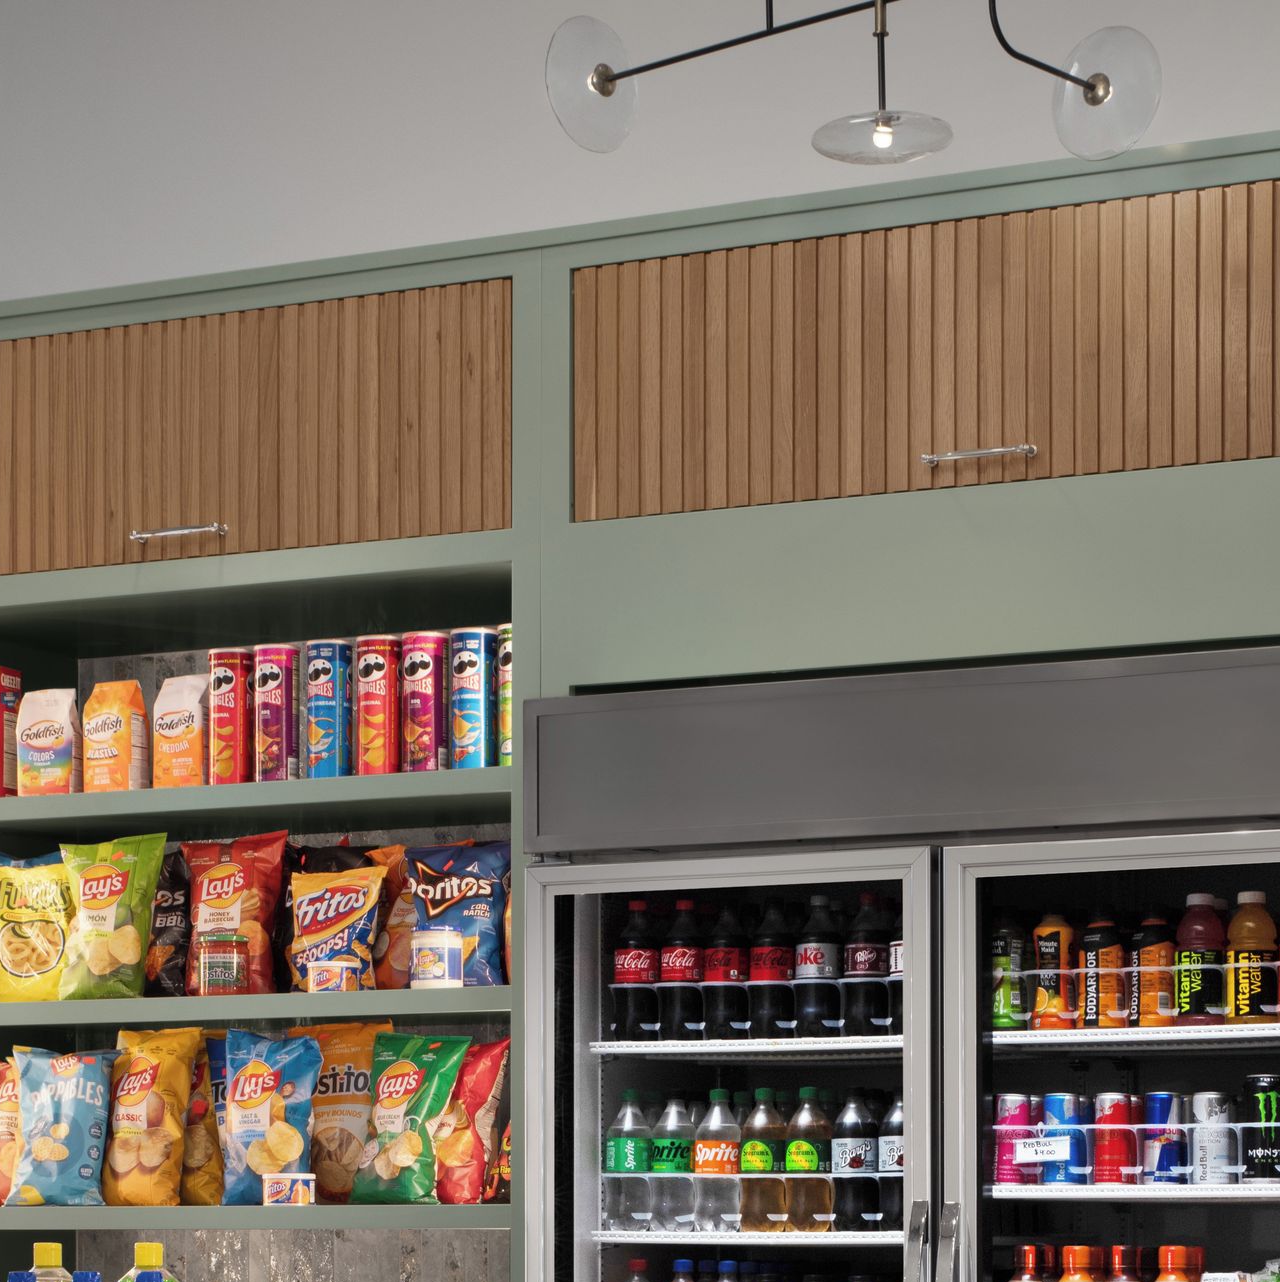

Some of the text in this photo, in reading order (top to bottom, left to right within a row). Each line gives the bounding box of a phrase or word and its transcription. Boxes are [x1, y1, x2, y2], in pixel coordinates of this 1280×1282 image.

[21, 724, 65, 743] Goldfish
[83, 715, 122, 738] Goldfish
[155, 711, 195, 732] Goldfish
[28, 751, 55, 761] COLORS
[158, 740, 189, 753] CHEDDAR
[80, 874, 123, 901] Lay's
[201, 870, 244, 900] Lay's
[409, 876, 492, 901] Doritos
[297, 886, 369, 925] Fritos
[463, 909, 491, 918] RANCH
[296, 929, 349, 965] SCOOPS!
[1038, 940, 1058, 948] Minute
[1179, 951, 1191, 1013] vitamin
[1191, 951, 1203, 992] water
[1238, 952, 1250, 1015] vitamin
[1250, 952, 1261, 995] water
[1086, 951, 1097, 1020] BODYARMOR
[54, 1056, 78, 1073] Lay's
[117, 1067, 153, 1096] Lay's
[234, 1071, 275, 1101] Lay's
[379, 1070, 418, 1097] Lay's
[115, 1113, 143, 1122] CLASSIC
[332, 1110, 362, 1118] ROUNDS
[624, 1140, 635, 1169] Sprite
[695, 1143, 739, 1162] Sprite
